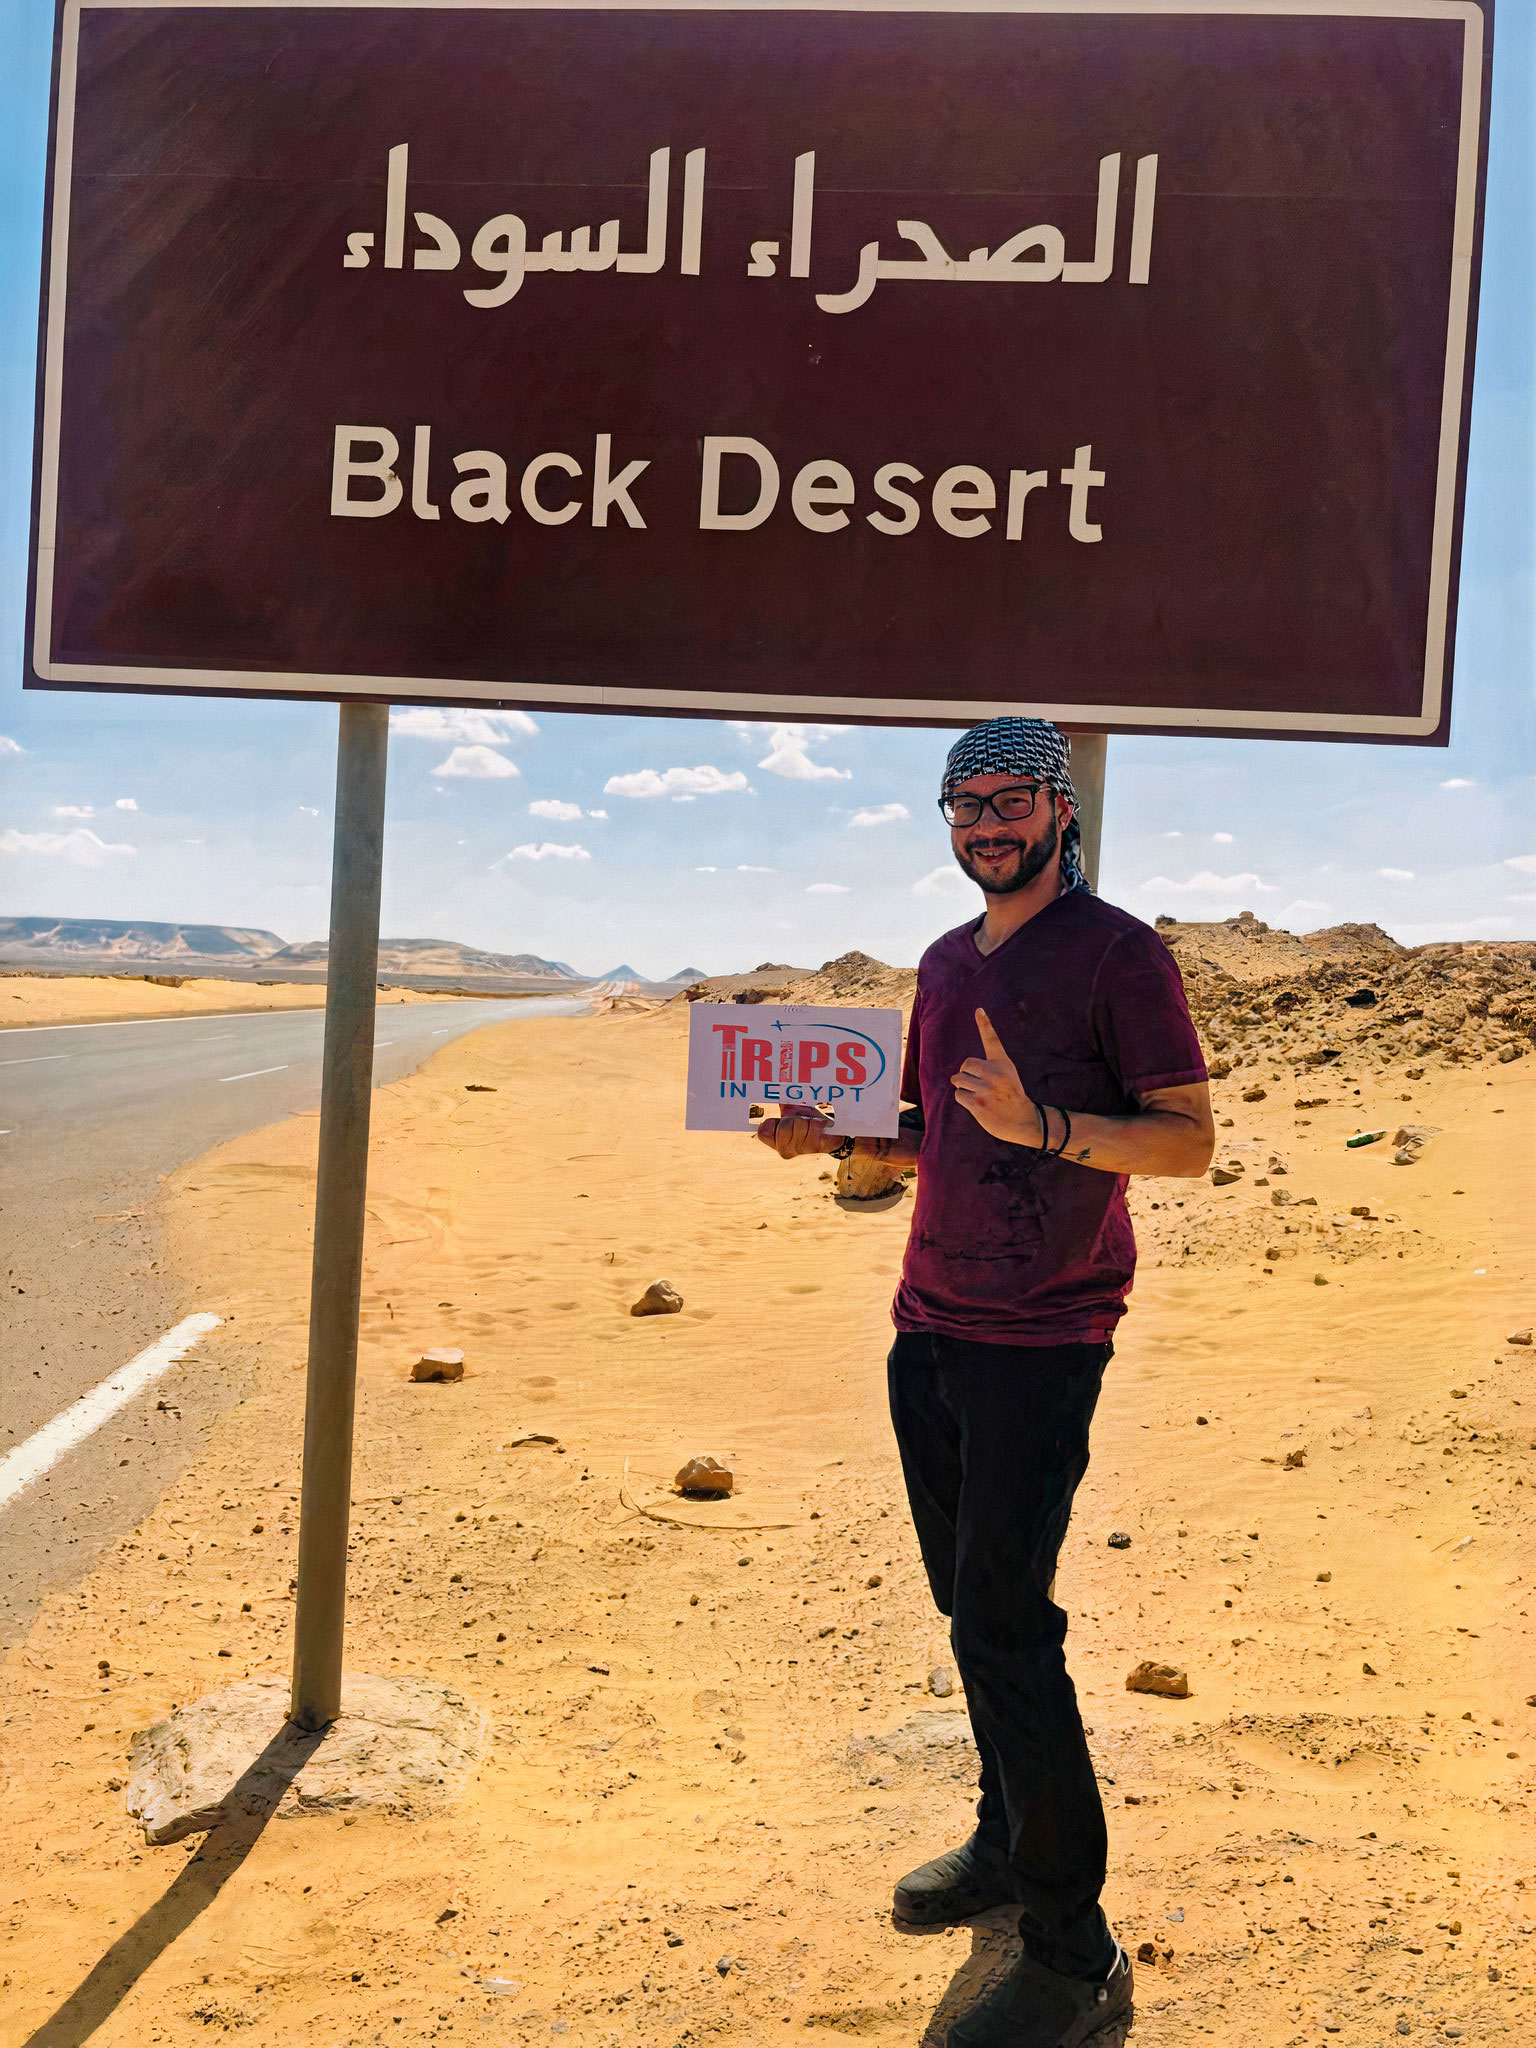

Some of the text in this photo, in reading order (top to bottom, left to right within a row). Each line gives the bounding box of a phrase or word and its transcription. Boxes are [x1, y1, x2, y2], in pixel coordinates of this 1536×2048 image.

[343, 143, 1159, 314] الصحراء السوداء
[330, 425, 1106, 543] Black Desert
[712, 1024, 867, 1086] TRIPS
[720, 1082, 865, 1103] IN EGYPT
